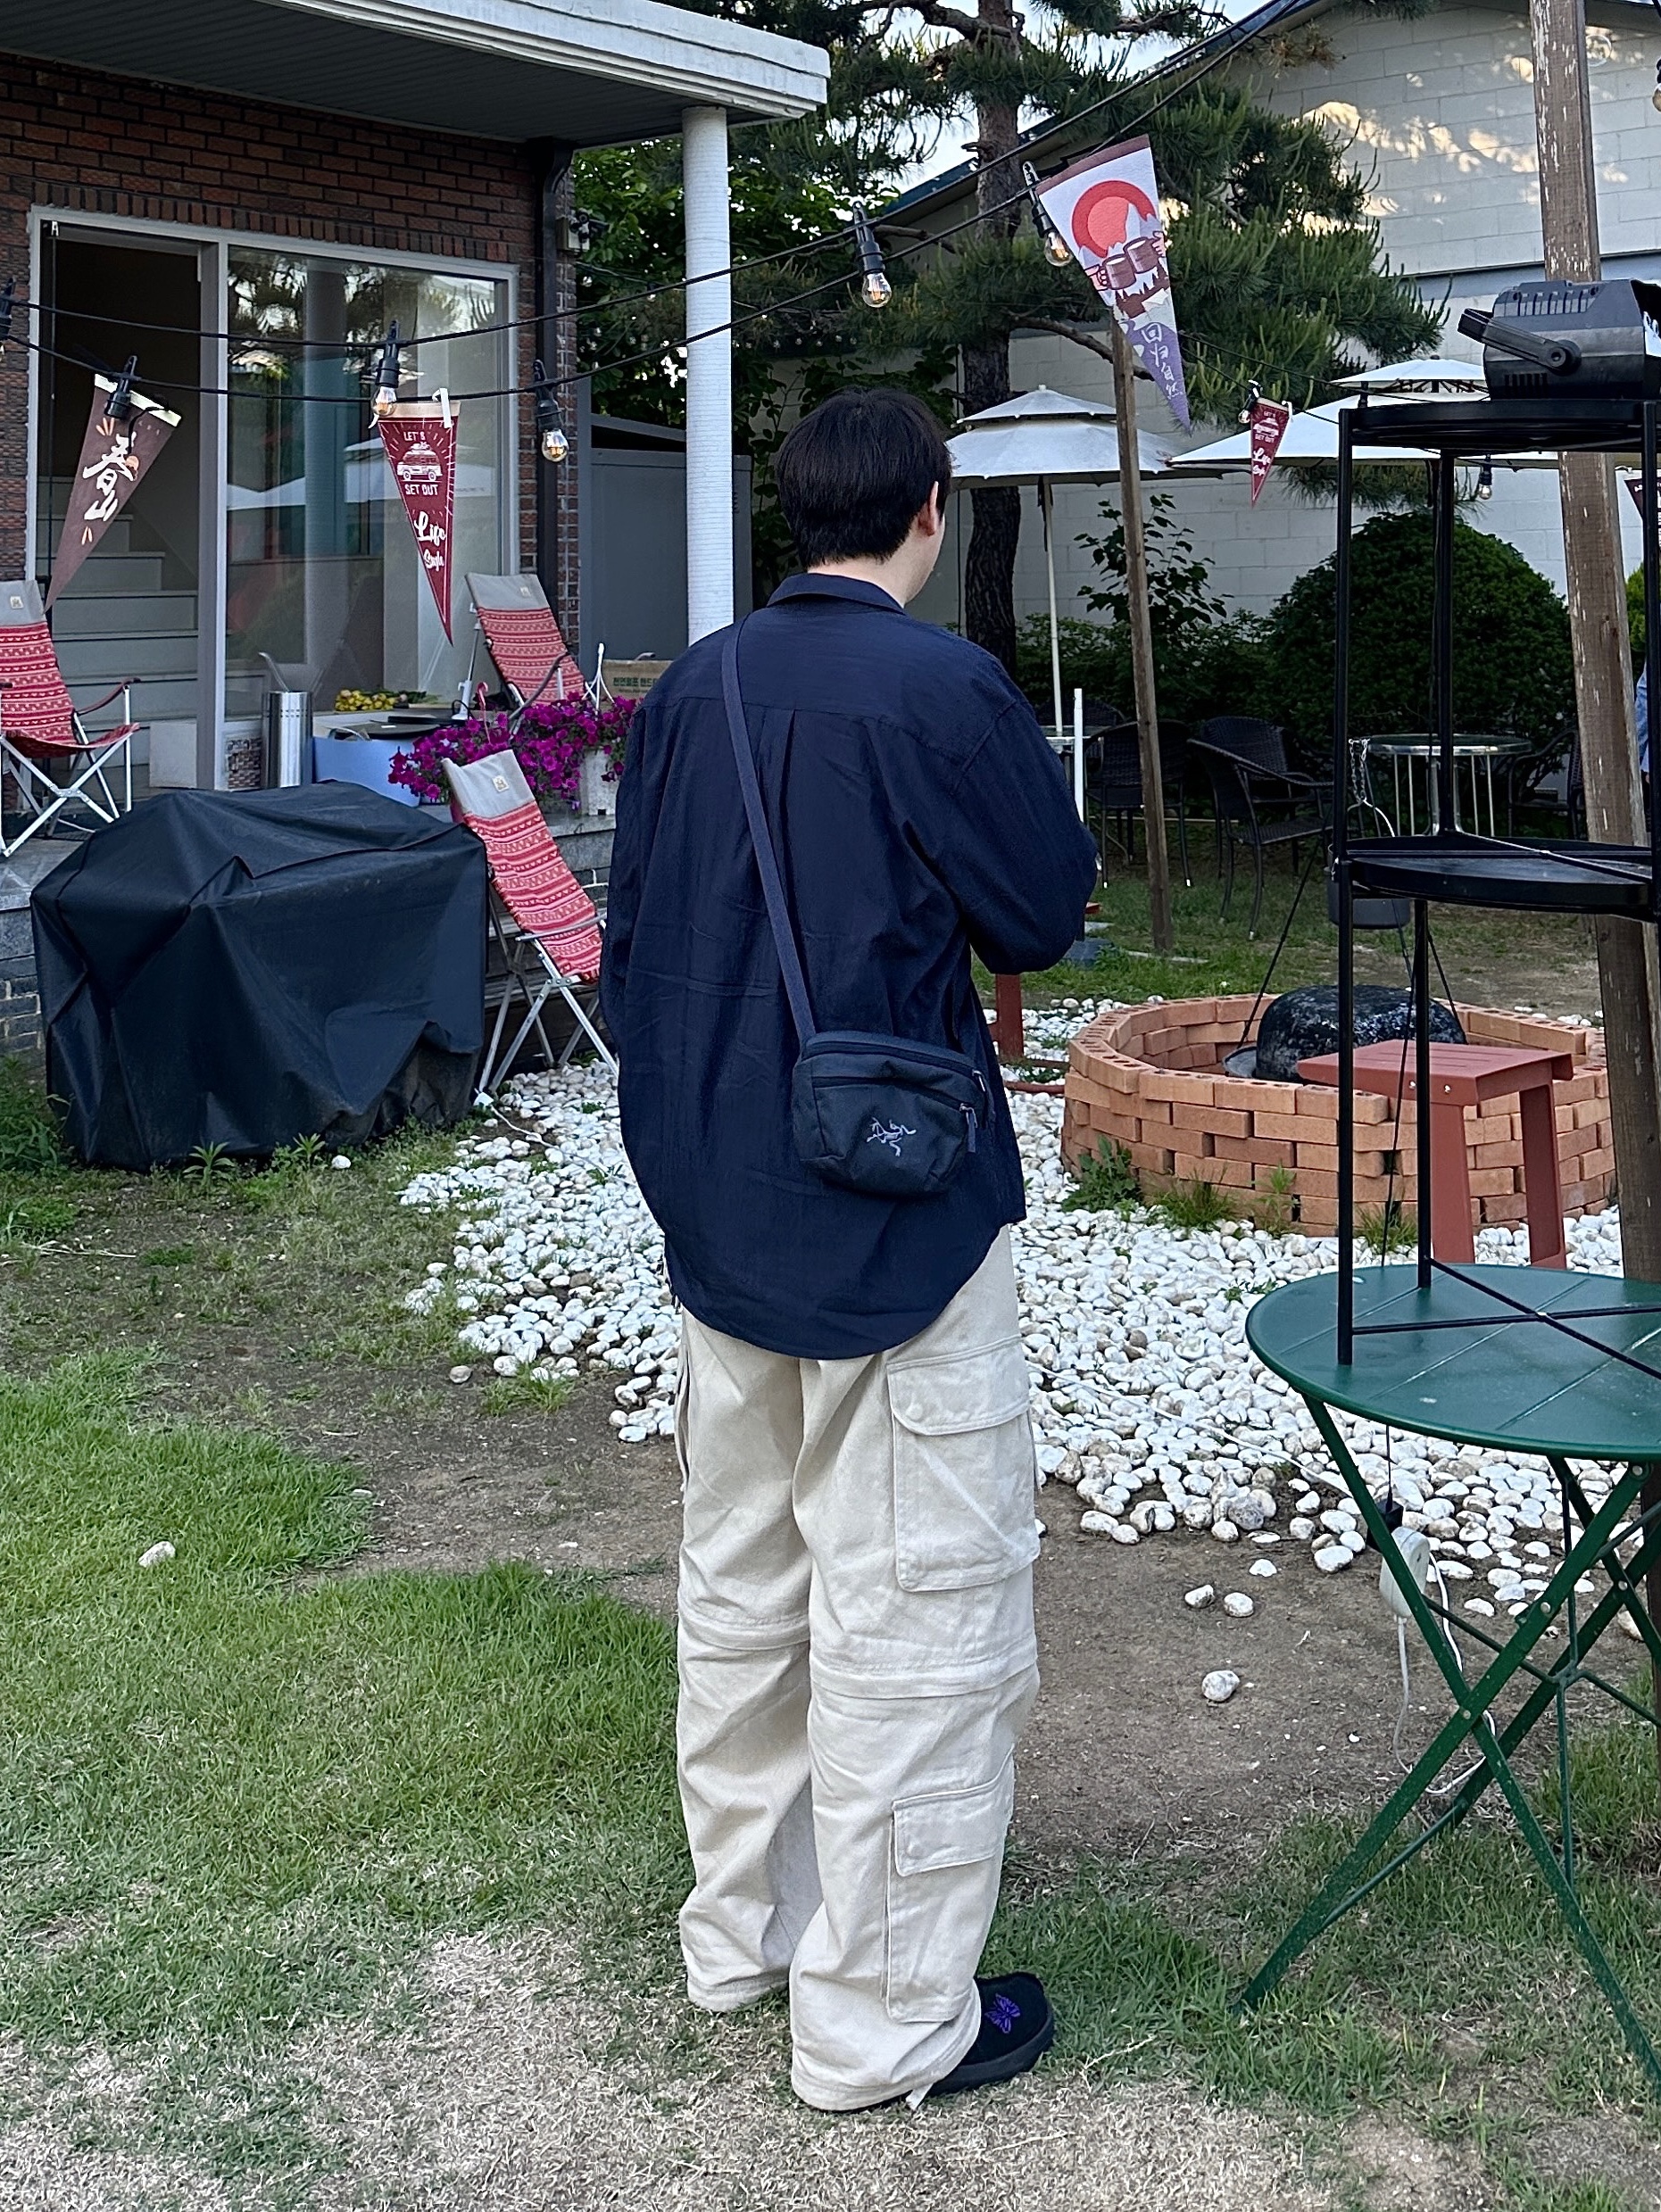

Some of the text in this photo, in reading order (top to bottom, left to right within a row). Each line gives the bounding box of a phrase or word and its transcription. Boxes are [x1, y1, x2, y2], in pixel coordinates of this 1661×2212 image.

[403, 431, 426, 441] LET'S
[404, 484, 438, 495] SET OUT
[413, 510, 446, 547] Life
